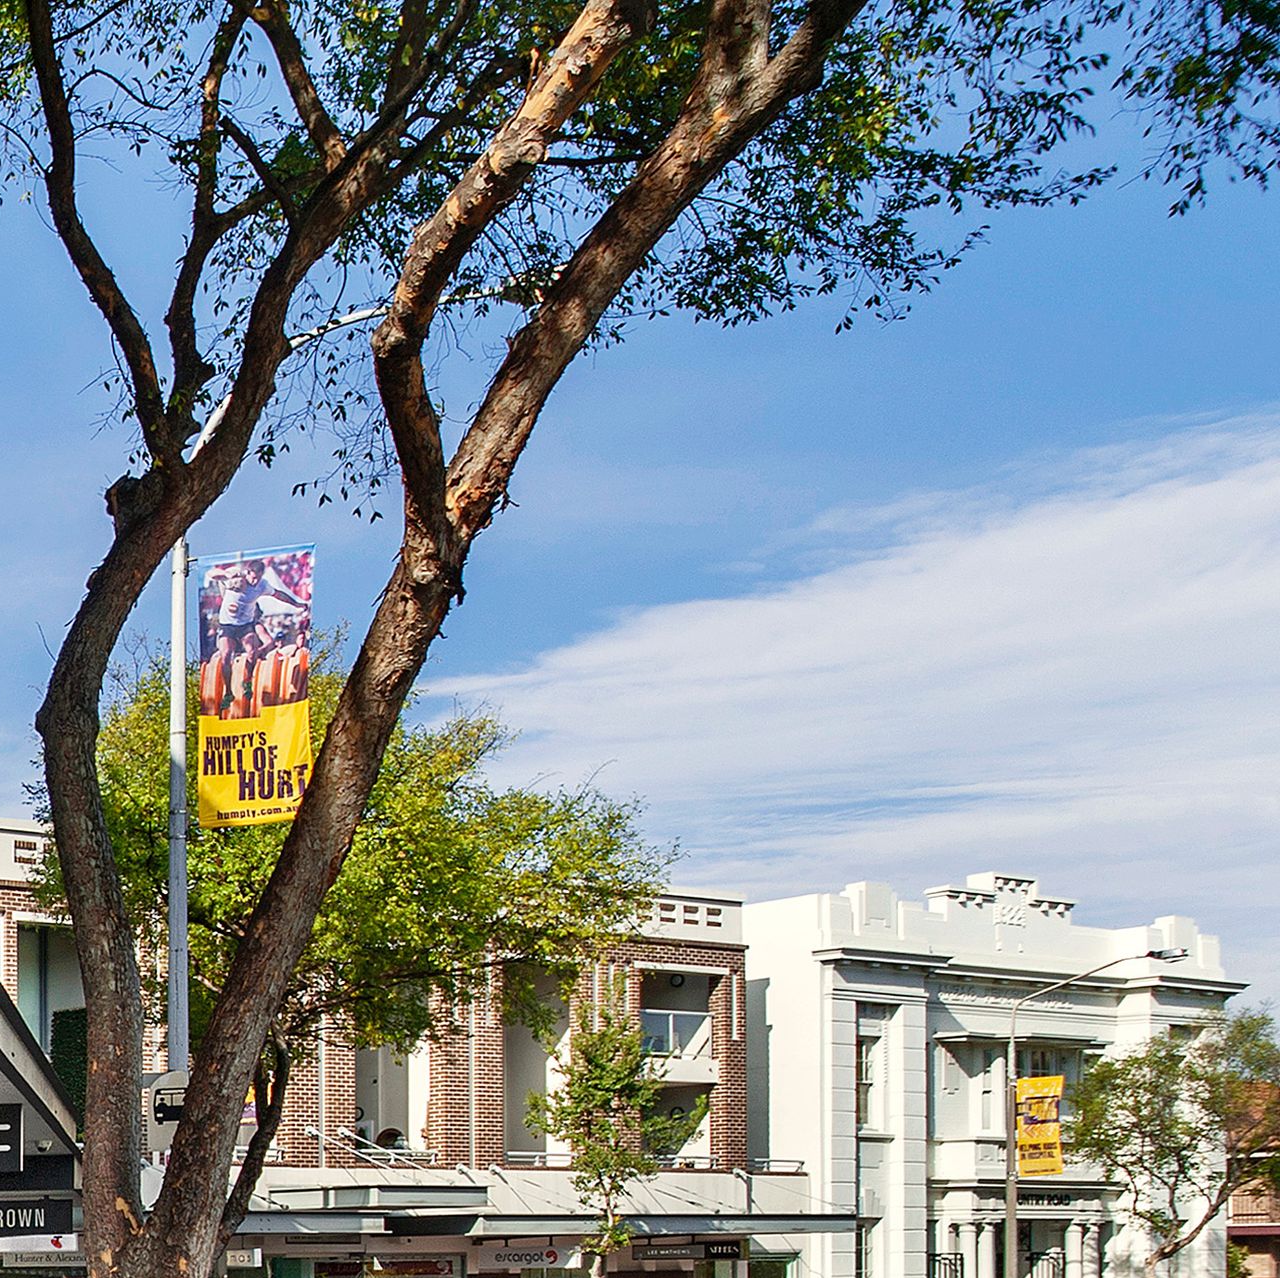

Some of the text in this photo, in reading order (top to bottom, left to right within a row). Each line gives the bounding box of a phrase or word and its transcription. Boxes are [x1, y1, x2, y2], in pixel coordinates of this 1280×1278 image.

[205, 731, 267, 751] HUMPTY'S
[203, 745, 278, 776] HILL OF
[238, 764, 308, 801] HURT
[45, 1253, 52, 1262] &
[495, 1251, 545, 1265] escargot
